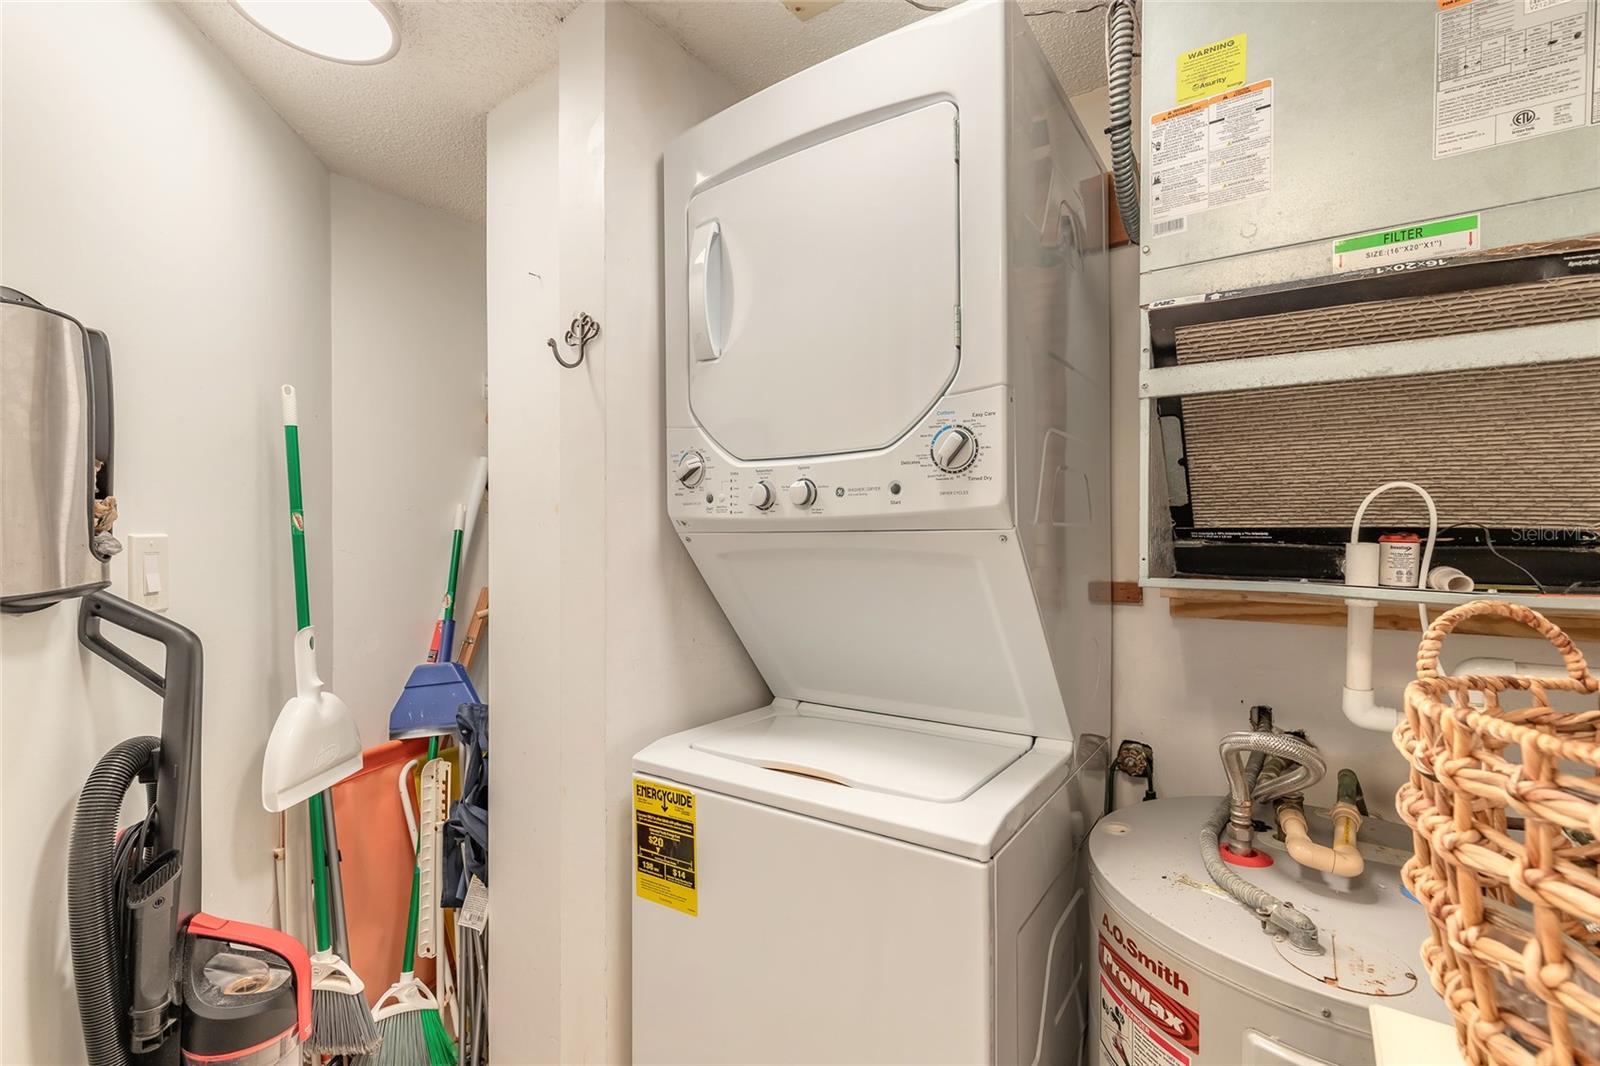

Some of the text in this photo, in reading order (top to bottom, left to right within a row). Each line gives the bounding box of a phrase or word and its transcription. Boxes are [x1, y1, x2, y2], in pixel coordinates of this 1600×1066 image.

[1188, 39, 1235, 60] WARNING
[1200, 76, 1227, 89] Asurity
[1383, 227, 1423, 245] FILTER
[983, 474, 993, 482] Dry
[636, 783, 693, 809] ENERGYGUIDE
[647, 835, 664, 848] $20
[672, 867, 686, 879] $14
[1103, 943, 1185, 1035] ProMax
